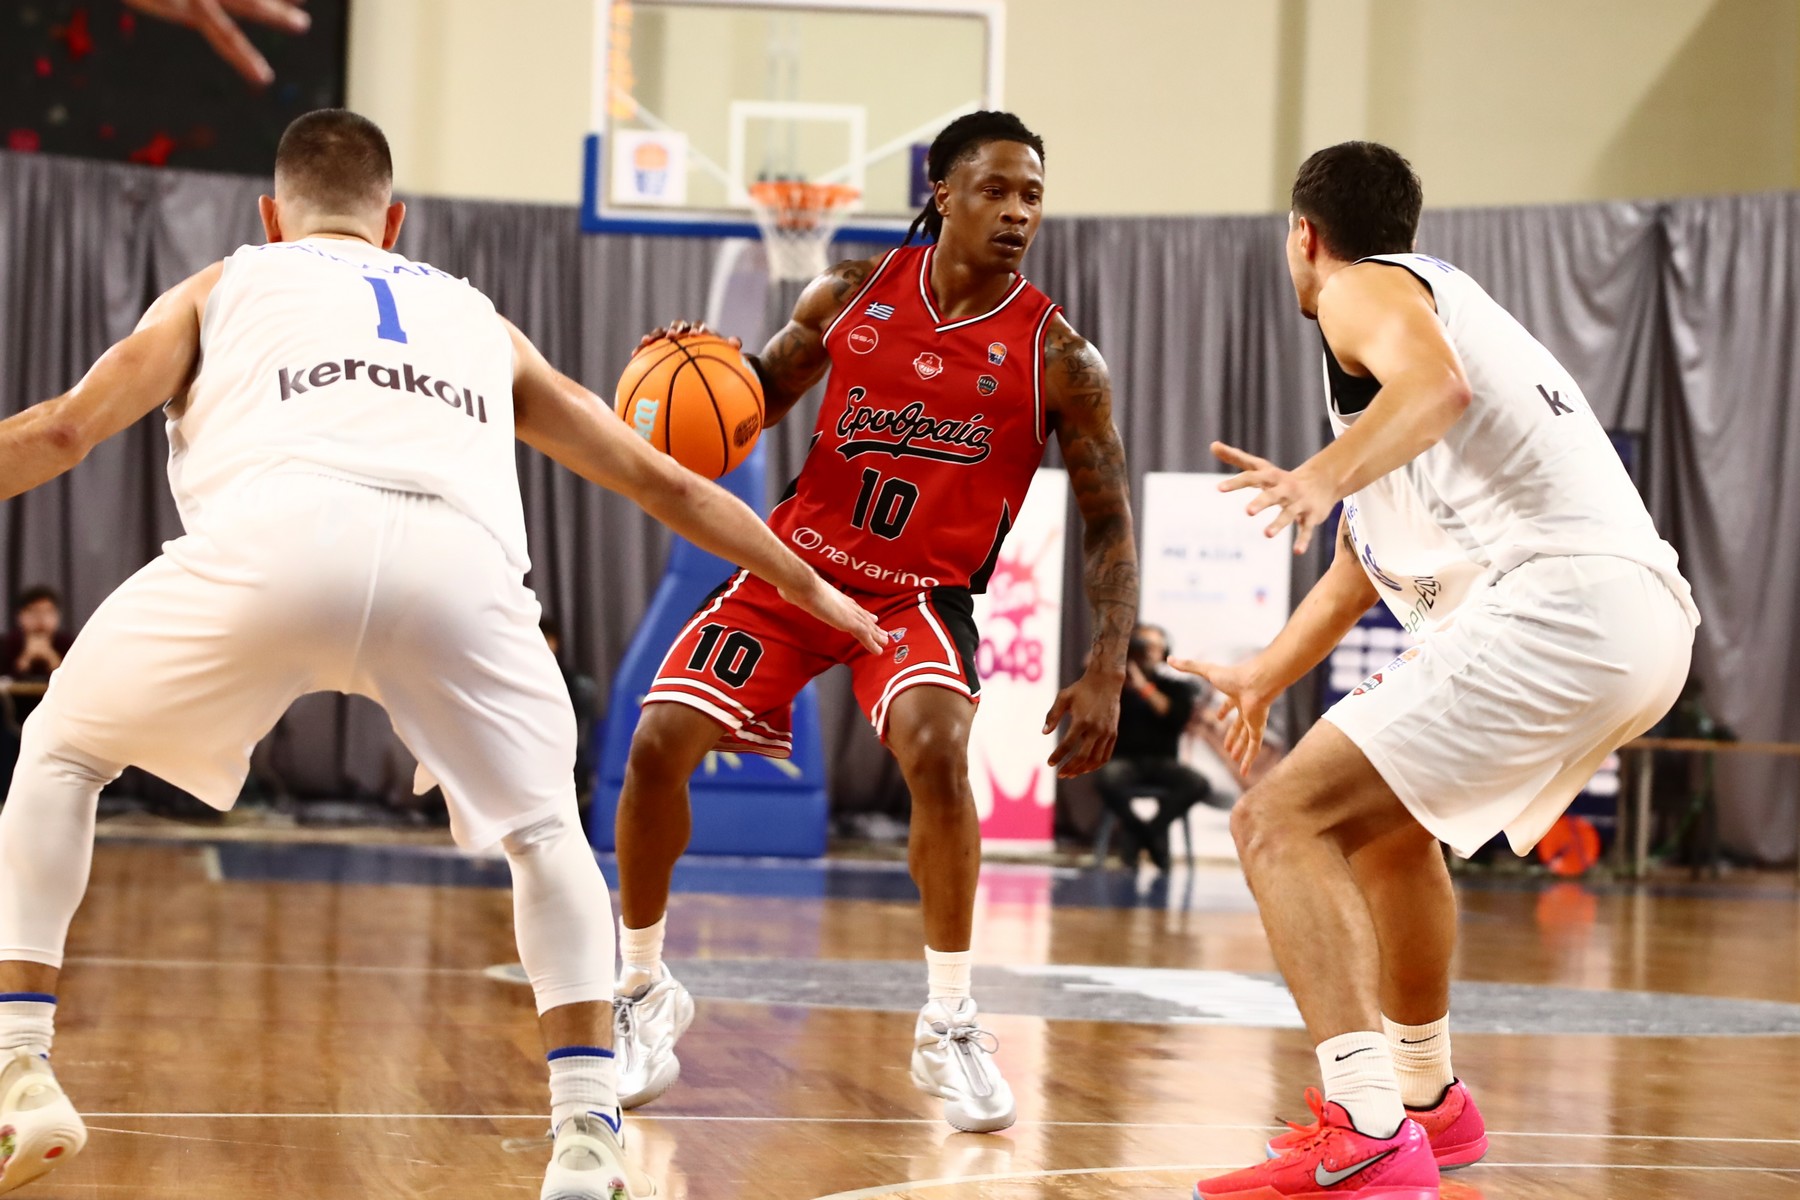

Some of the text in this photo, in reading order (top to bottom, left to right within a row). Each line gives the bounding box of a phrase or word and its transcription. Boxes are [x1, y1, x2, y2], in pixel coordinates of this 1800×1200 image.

[363, 275, 408, 344] 1
[278, 358, 488, 424] kerakoll
[850, 466, 920, 541] 10
[819, 544, 940, 588] navarino
[685, 622, 764, 689] 10
